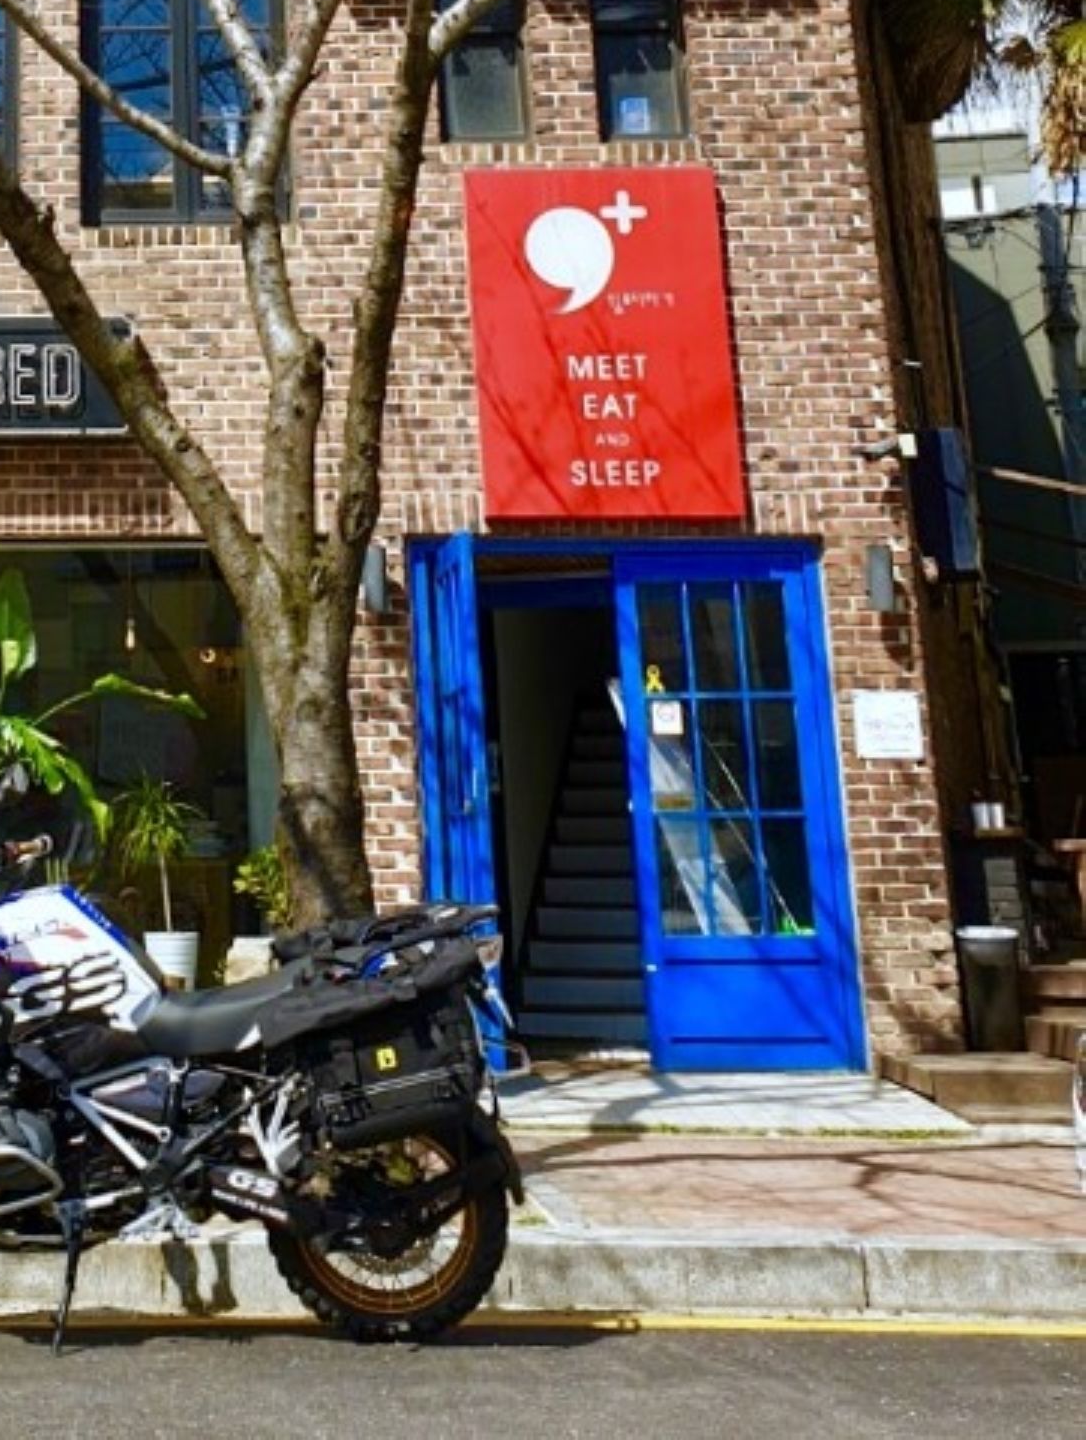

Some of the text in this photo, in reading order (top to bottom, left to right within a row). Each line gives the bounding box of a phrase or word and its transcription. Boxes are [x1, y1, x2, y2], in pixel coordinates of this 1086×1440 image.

[567, 354, 648, 381] MEET
[582, 393, 638, 420] EAT
[594, 432, 631, 447] AND
[570, 460, 661, 488] SLEEP
[2, 951, 127, 1023] GS
